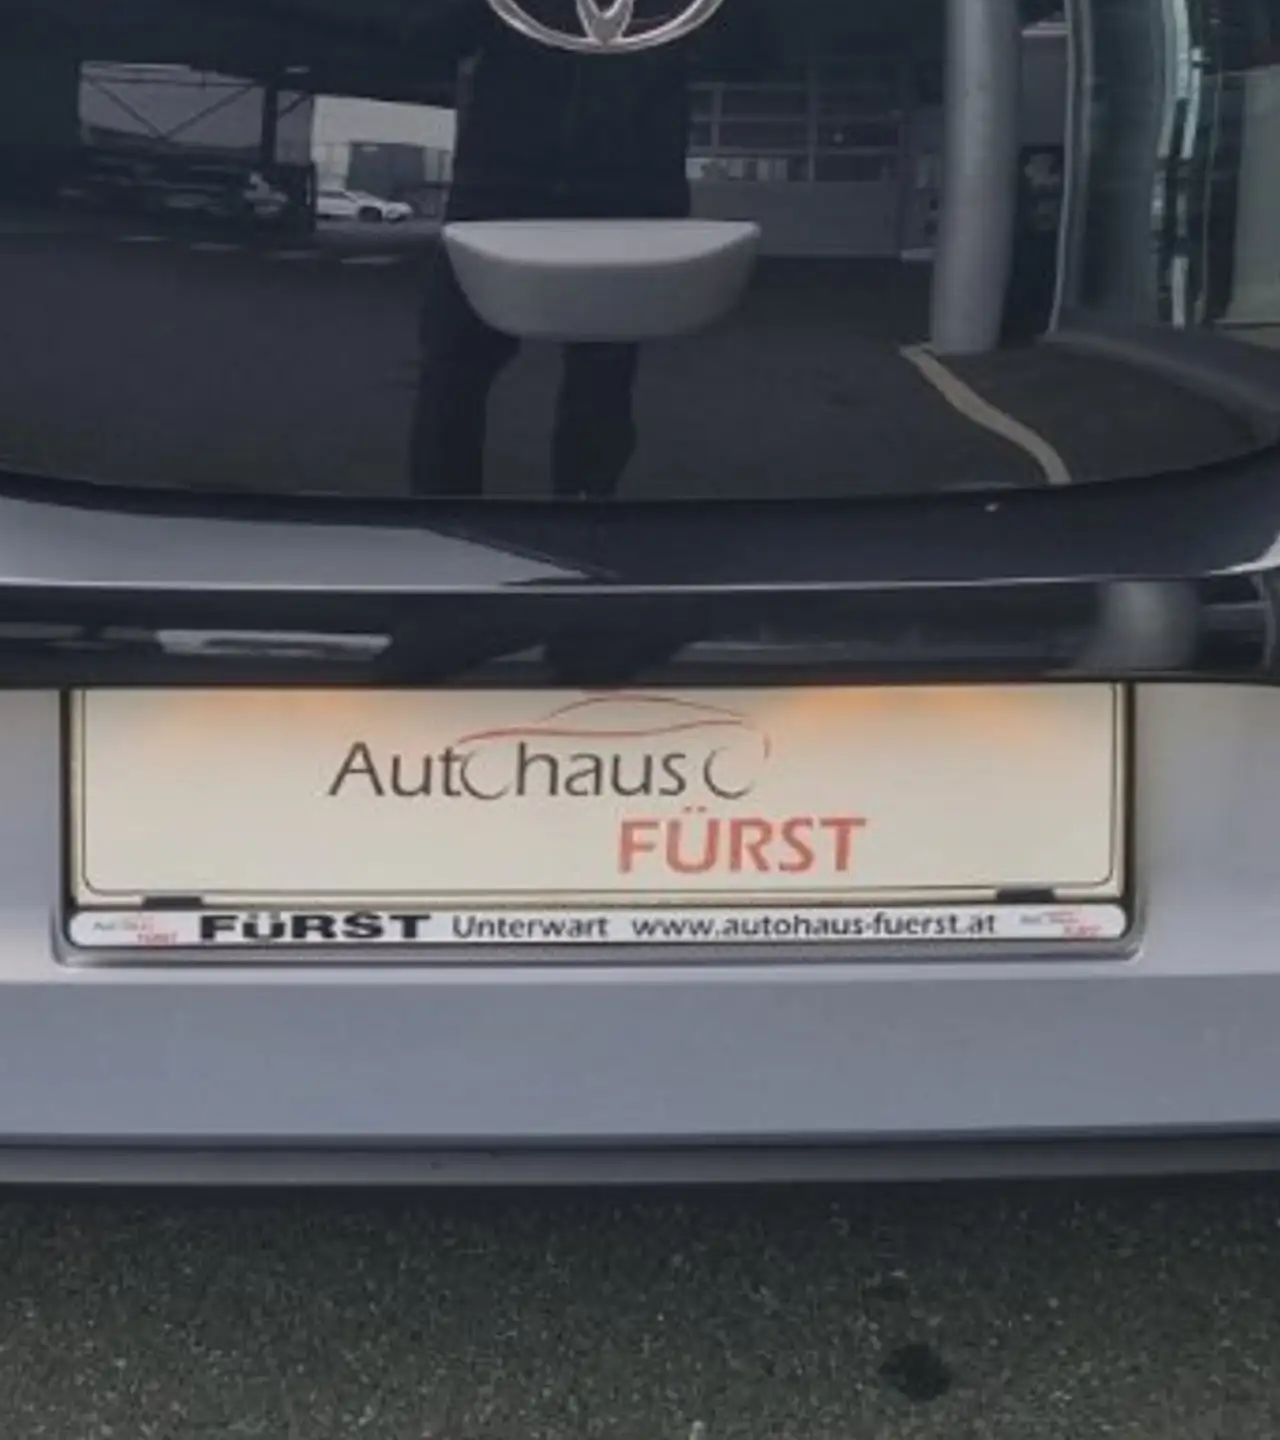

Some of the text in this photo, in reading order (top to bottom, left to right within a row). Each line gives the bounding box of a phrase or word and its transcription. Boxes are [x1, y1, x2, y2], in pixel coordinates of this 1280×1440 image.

[619, 805, 867, 874] FÜRST
[452, 914, 610, 940] Unterwart
[630, 912, 997, 940] www.autohaus-fuerst.at
